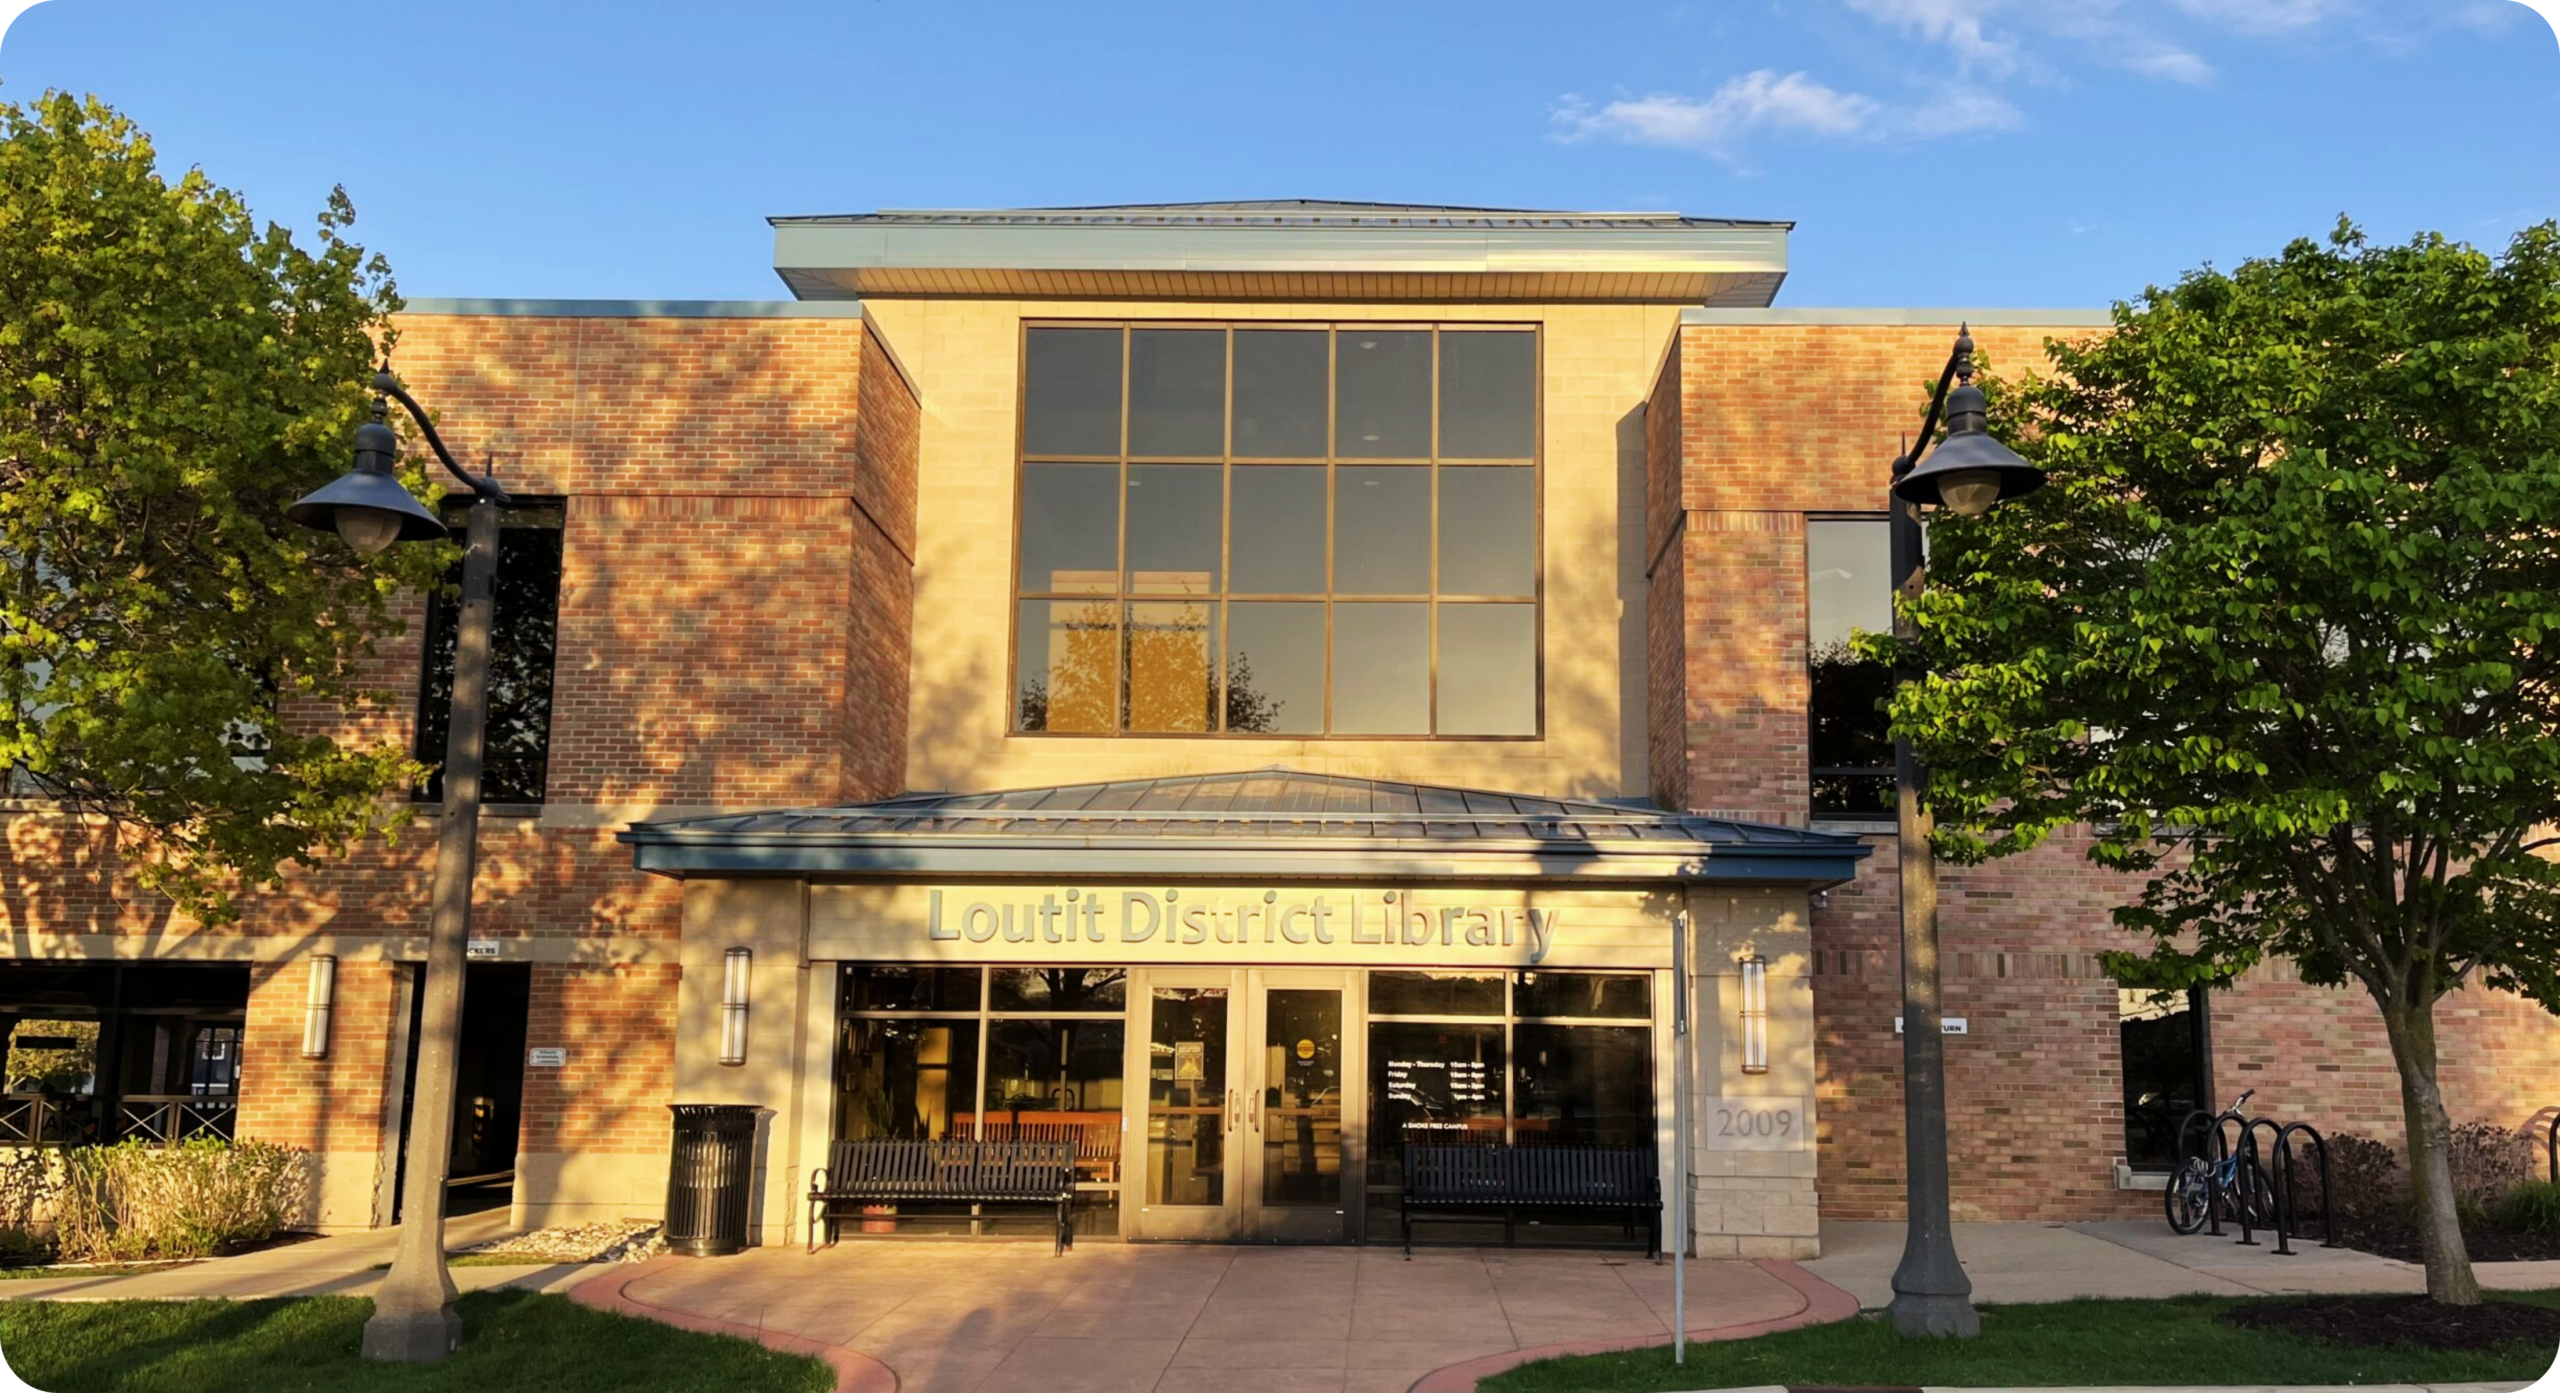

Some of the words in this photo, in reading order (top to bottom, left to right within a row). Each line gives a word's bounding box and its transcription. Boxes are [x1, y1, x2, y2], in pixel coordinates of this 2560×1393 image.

[929, 888, 1105, 943] Loutit
[1121, 888, 1335, 944] District
[1351, 888, 1561, 963] Library
[1388, 1061, 1412, 1069] Monday
[1416, 1061, 1445, 1069] Thursday
[1388, 1071, 1408, 1079] Friday
[1388, 1082, 1416, 1090] Saturday
[1388, 1092, 1411, 1101] Sunday
[1429, 1122, 1443, 1130] FREE
[1717, 1108, 1793, 1136] 2009
